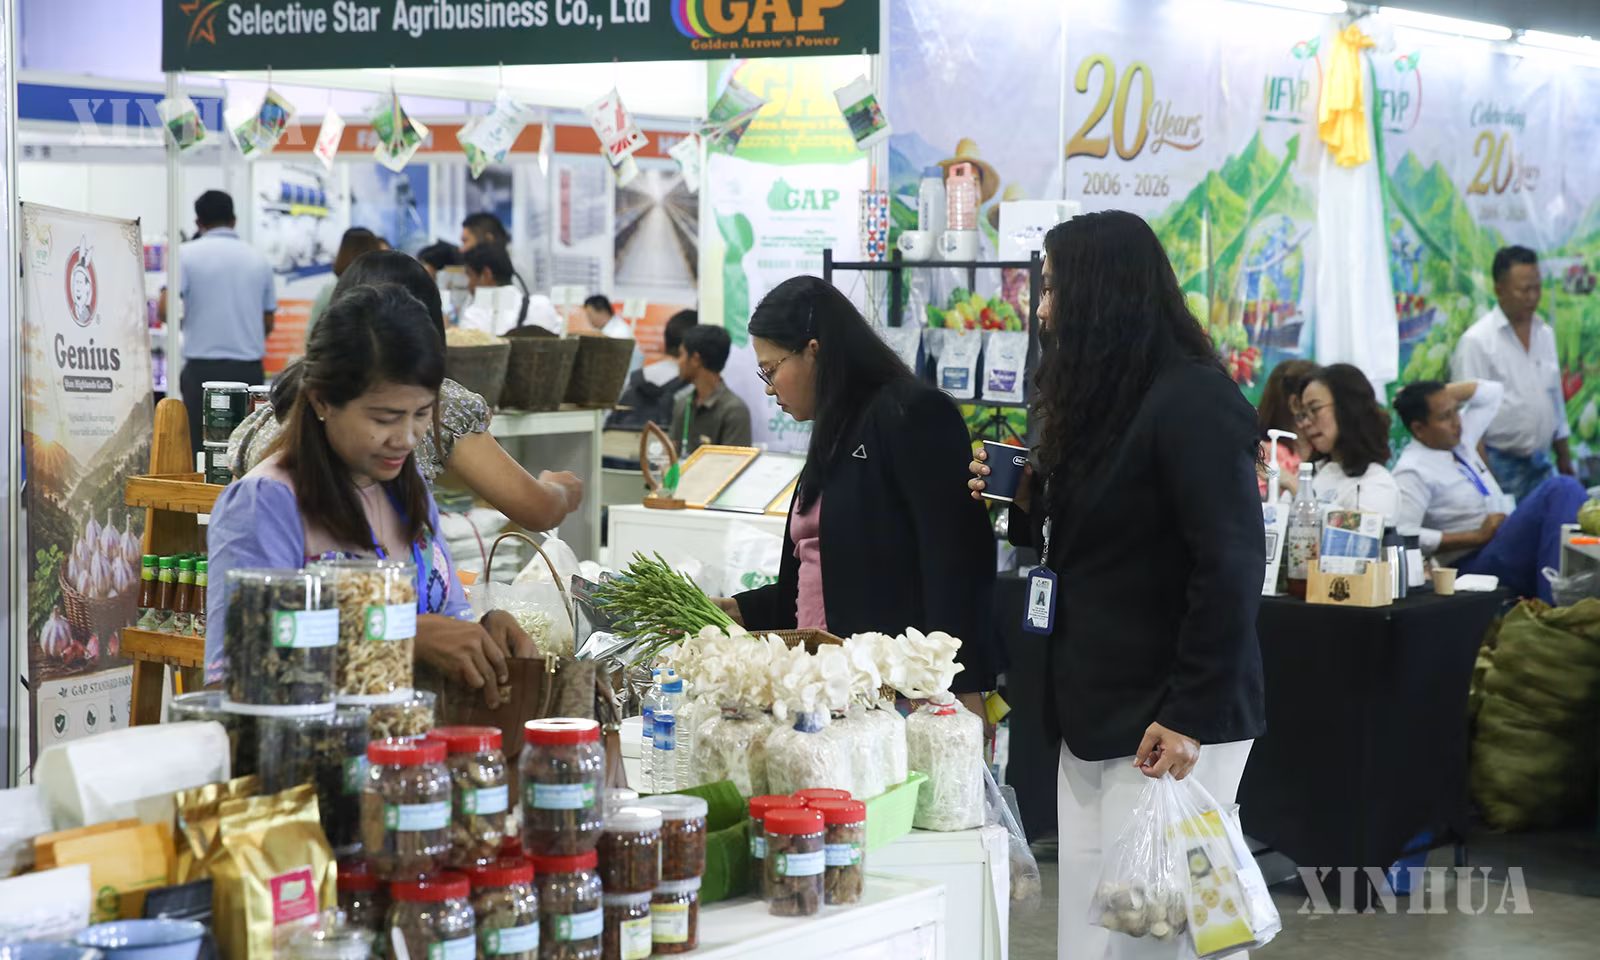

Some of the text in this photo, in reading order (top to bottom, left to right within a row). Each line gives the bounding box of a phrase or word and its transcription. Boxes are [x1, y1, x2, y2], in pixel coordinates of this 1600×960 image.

[228, 0, 650, 38] Selective Star Agribusiness Co., Ltd
[702, 0, 846, 34] GAP
[691, 36, 840, 50] Golden Arrow's Power
[1066, 53, 1204, 162] 20 Years
[1467, 131, 1514, 195] 20
[784, 189, 840, 211] GAP
[1083, 172, 1121, 195] 2006
[1134, 174, 1170, 197] 2026
[54, 332, 121, 372] Genius
[71, 684, 89, 696] GAP
